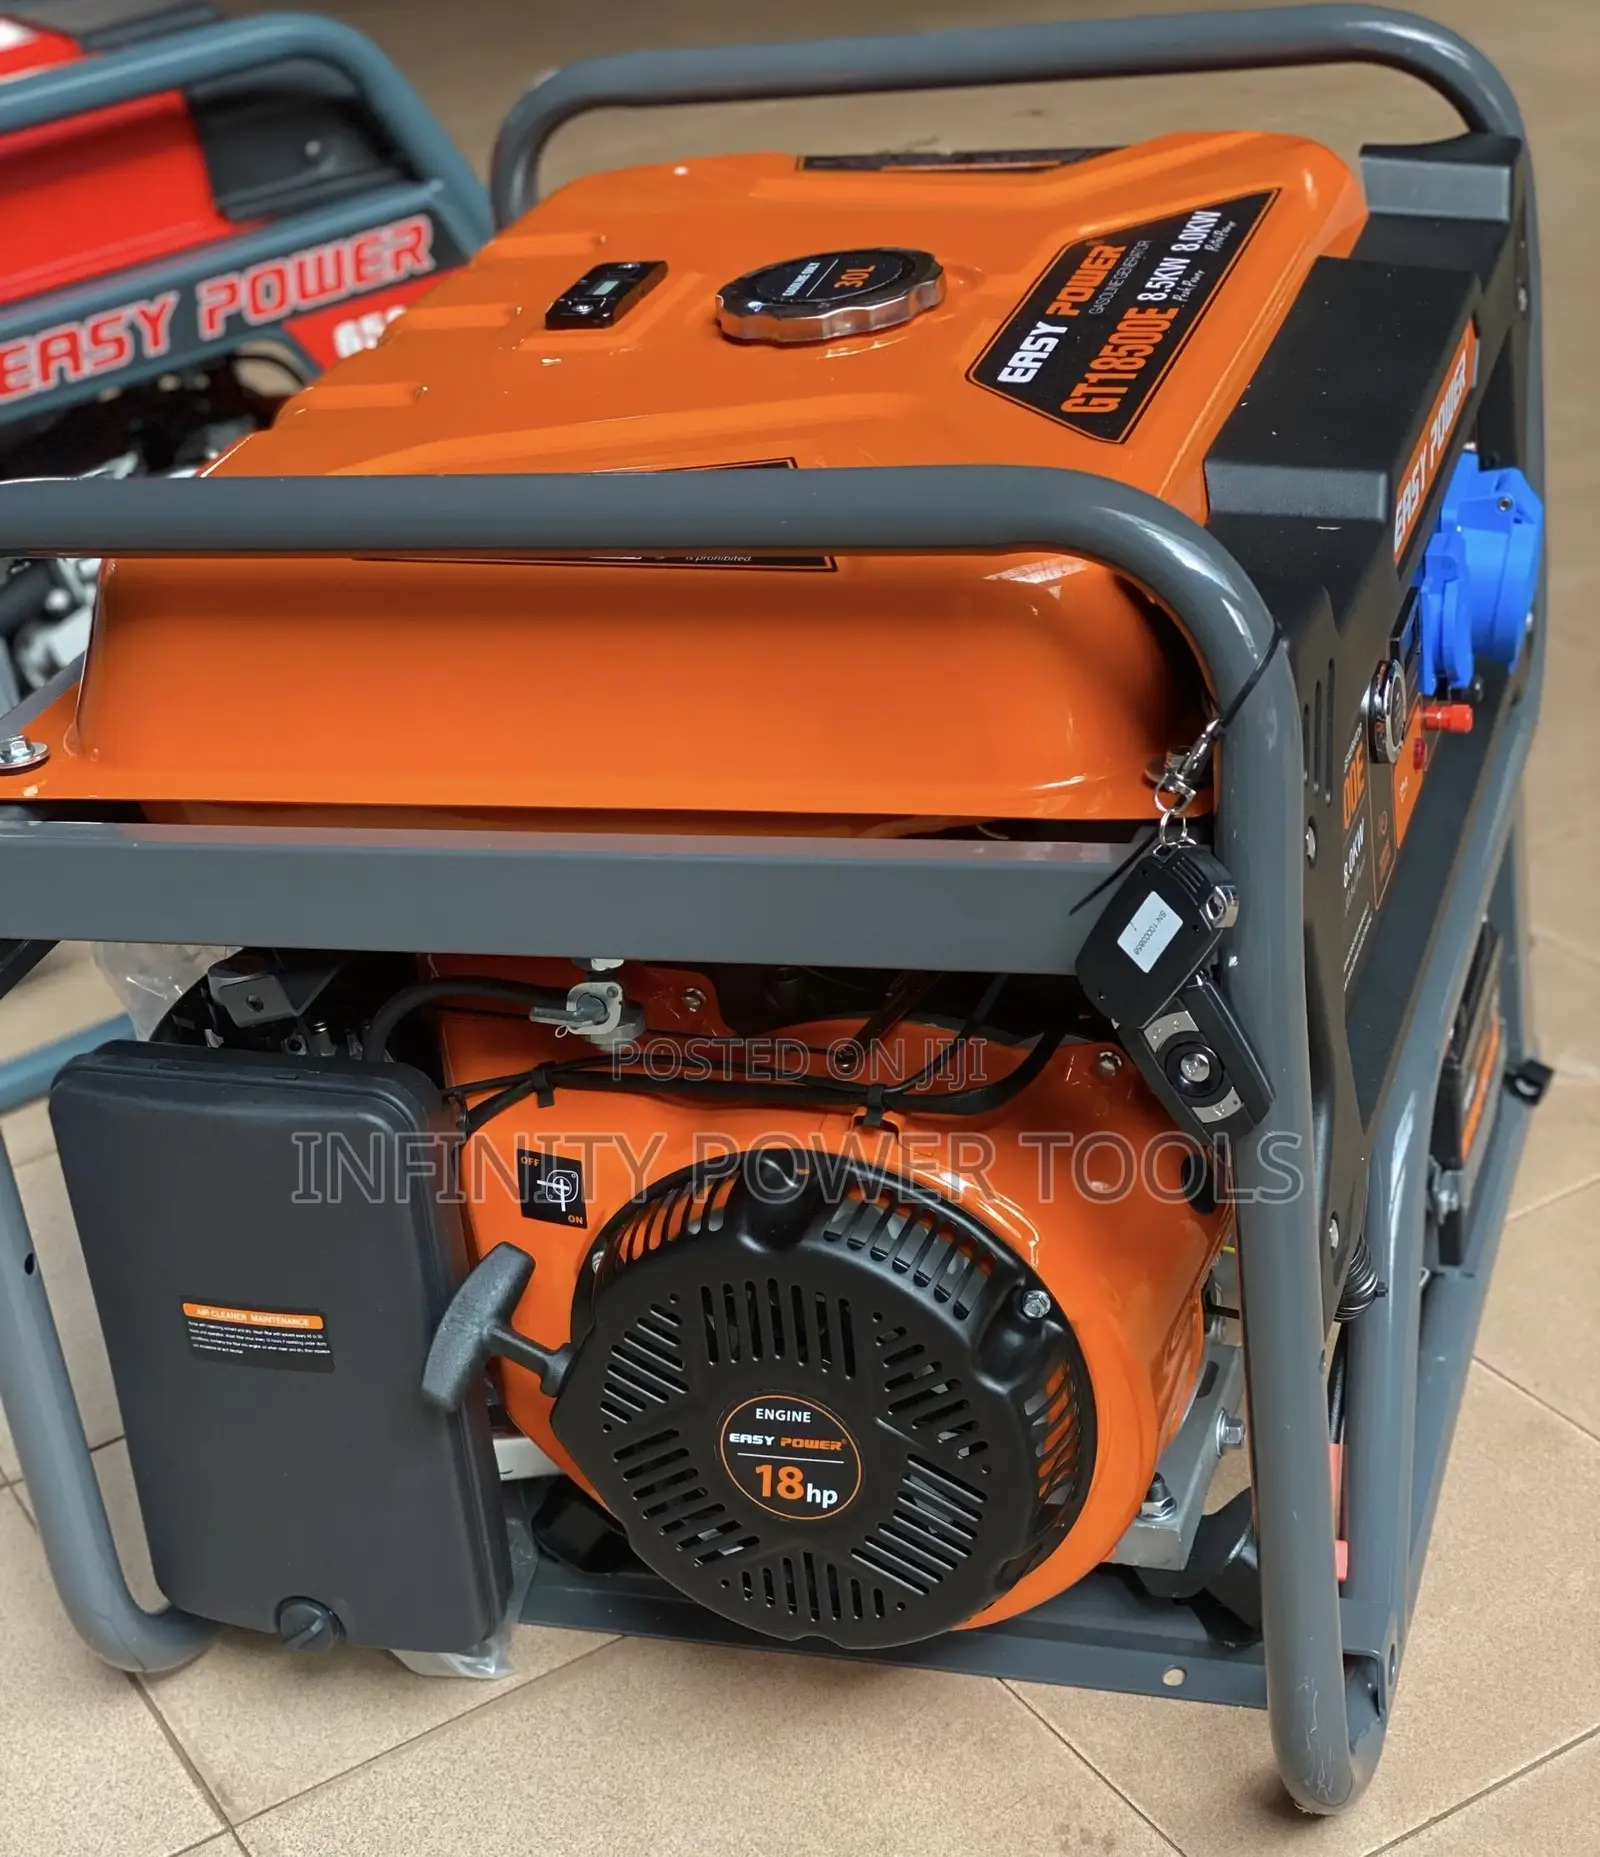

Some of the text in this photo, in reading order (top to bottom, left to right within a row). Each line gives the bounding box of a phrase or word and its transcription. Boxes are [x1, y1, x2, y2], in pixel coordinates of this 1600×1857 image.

[833, 265, 876, 289] 30L
[0, 213, 437, 401] EASY POWER
[997, 243, 1127, 384] EASY POWER
[1060, 211, 1221, 414] GT18500E 8.5KW 8.0KW
[1394, 350, 1466, 553] EASY POWER
[520, 1156, 541, 1167] OFF
[567, 1214, 583, 1225] ON
[755, 1408, 812, 1423] ENGINE
[729, 1432, 842, 1451] EASY POWER
